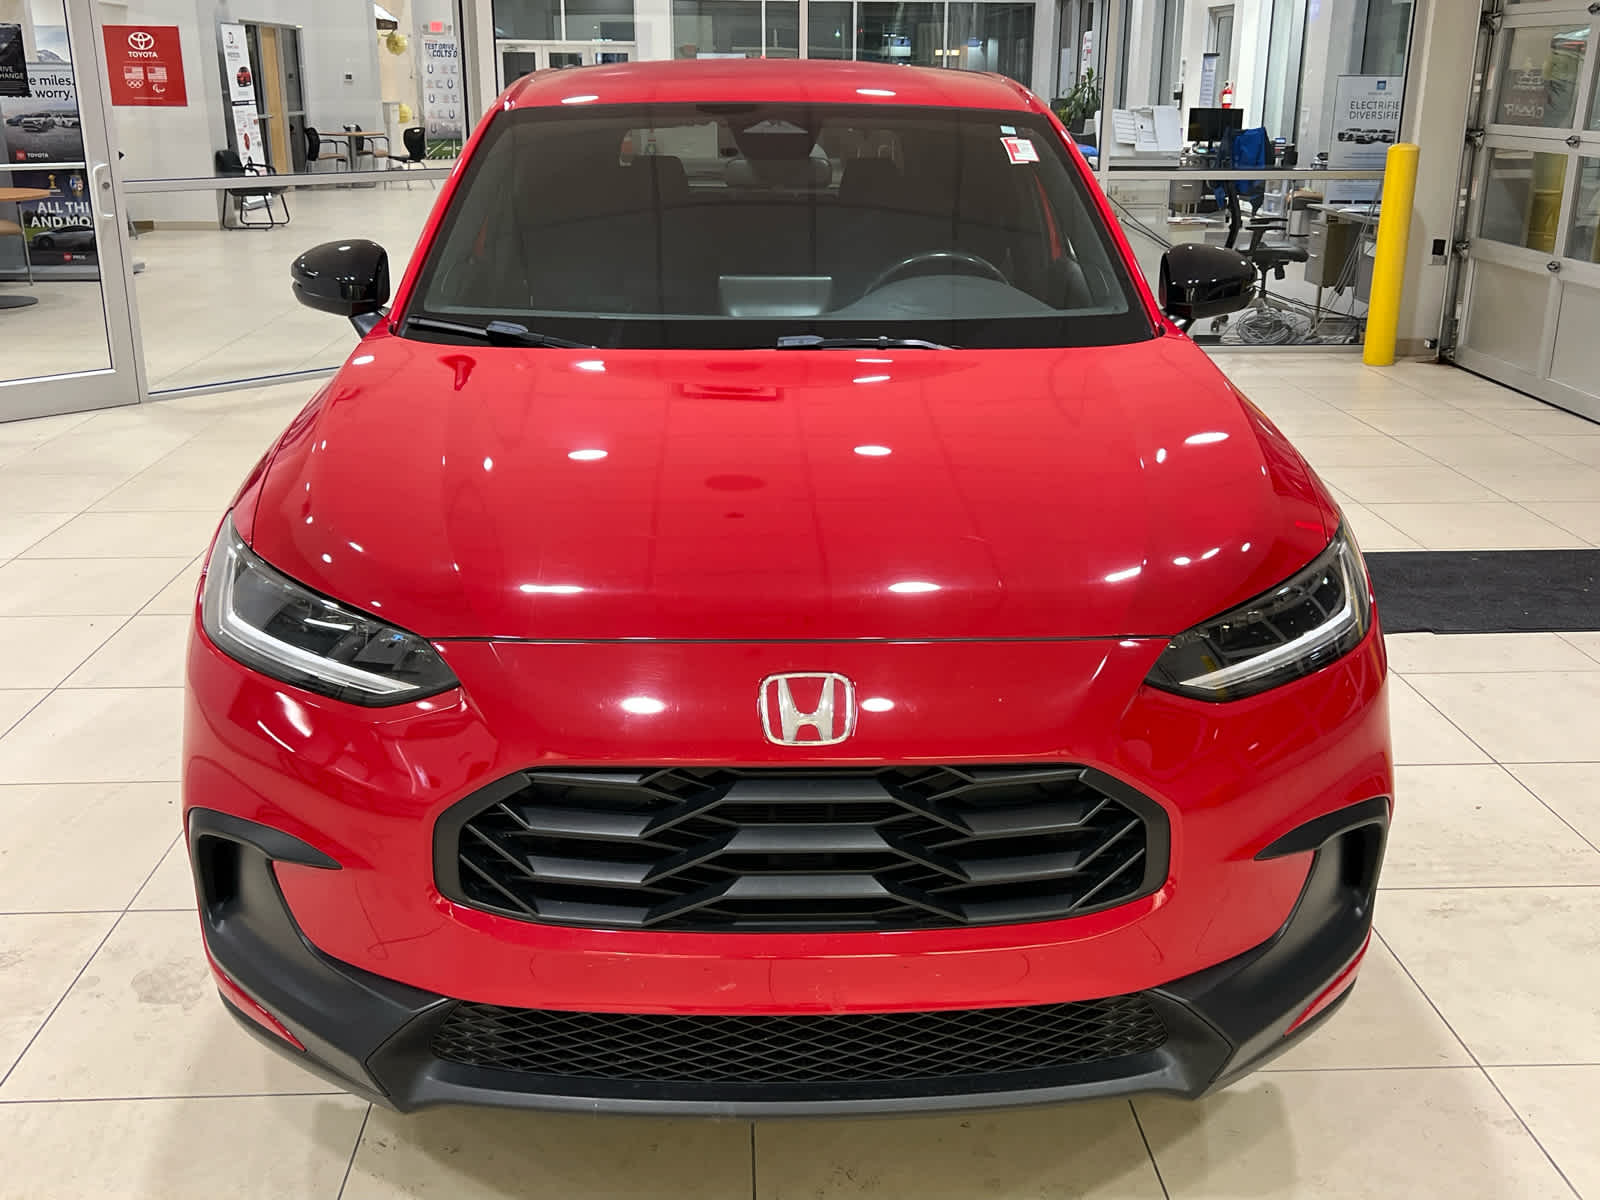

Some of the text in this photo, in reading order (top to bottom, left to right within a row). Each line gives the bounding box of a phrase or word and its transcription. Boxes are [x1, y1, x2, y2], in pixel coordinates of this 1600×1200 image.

[40, 74, 74, 86] miles.
[35, 89, 73, 101] worry.
[1350, 100, 1400, 110] ELECTRIFIE
[1349, 111, 1399, 120] DIVERSIFIE
[37, 201, 90, 213] ALL THI
[31, 216, 93, 228] AND MO
